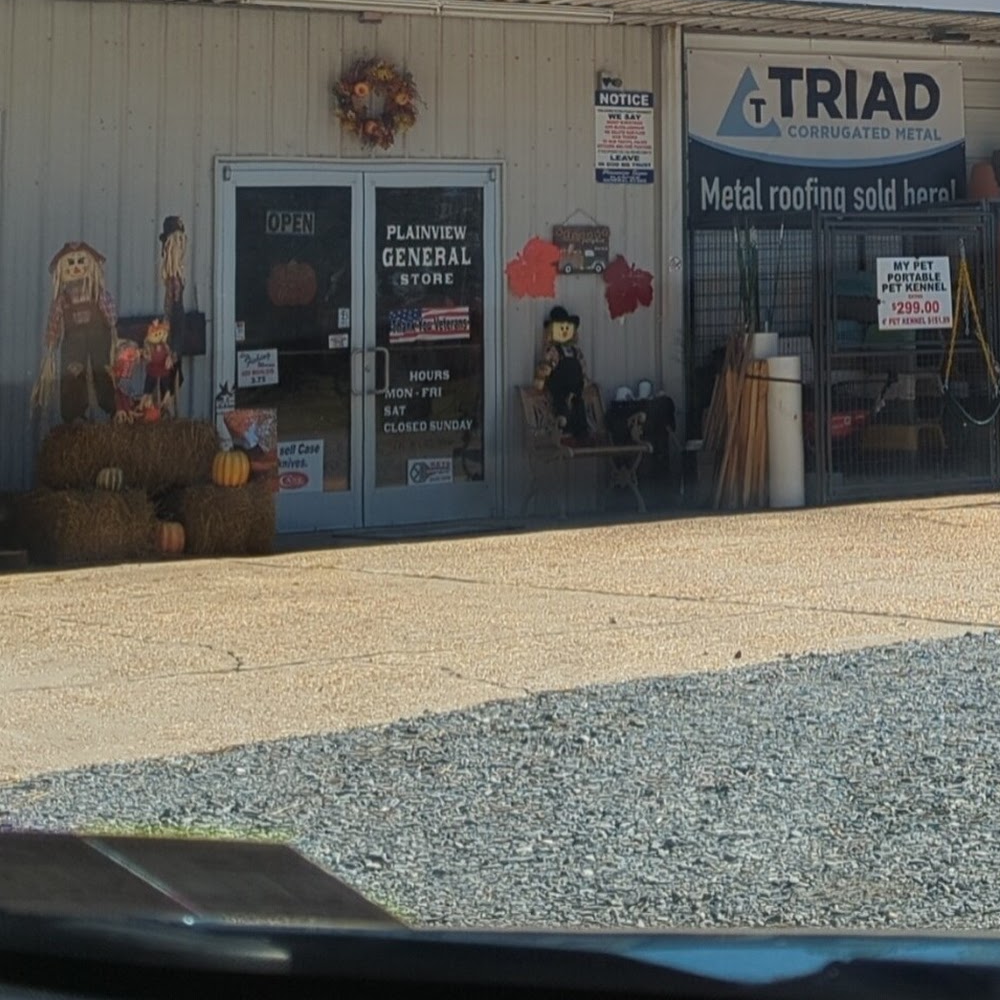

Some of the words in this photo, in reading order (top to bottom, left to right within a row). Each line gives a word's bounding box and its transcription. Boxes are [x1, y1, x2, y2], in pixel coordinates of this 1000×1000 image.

[600, 93, 649, 106] NOTICE
[769, 66, 941, 121] TRIAD
[624, 113, 641, 121] SAY
[788, 125, 890, 139] CORRUGATED
[895, 127, 941, 141] METAL
[701, 176, 763, 211] Metal
[770, 177, 846, 219] roofing
[853, 178, 896, 211] sold
[904, 179, 956, 206] here!
[268, 213, 313, 232] OPEN
[386, 225, 467, 240] PLAINVIEW
[382, 247, 471, 267] GENERAL
[894, 261, 910, 271] MY
[913, 261, 933, 271] PET
[400, 273, 454, 285] STORE
[887, 272, 941, 283] PORTABLE
[882, 283, 902, 293] PET
[905, 282, 947, 293] KENNEL
[891, 301, 940, 314] $299.00
[902, 317, 926, 325] KENNEL
[409, 370, 450, 381] HOURS
[384, 388, 413, 398] MON
[421, 387, 442, 398] FRI
[384, 405, 406, 416] SAT
[384, 421, 427, 433] CLOSED
[430, 420, 473, 431] SUNDAY
[280, 444, 296, 456] sell
[298, 442, 320, 455] Case
